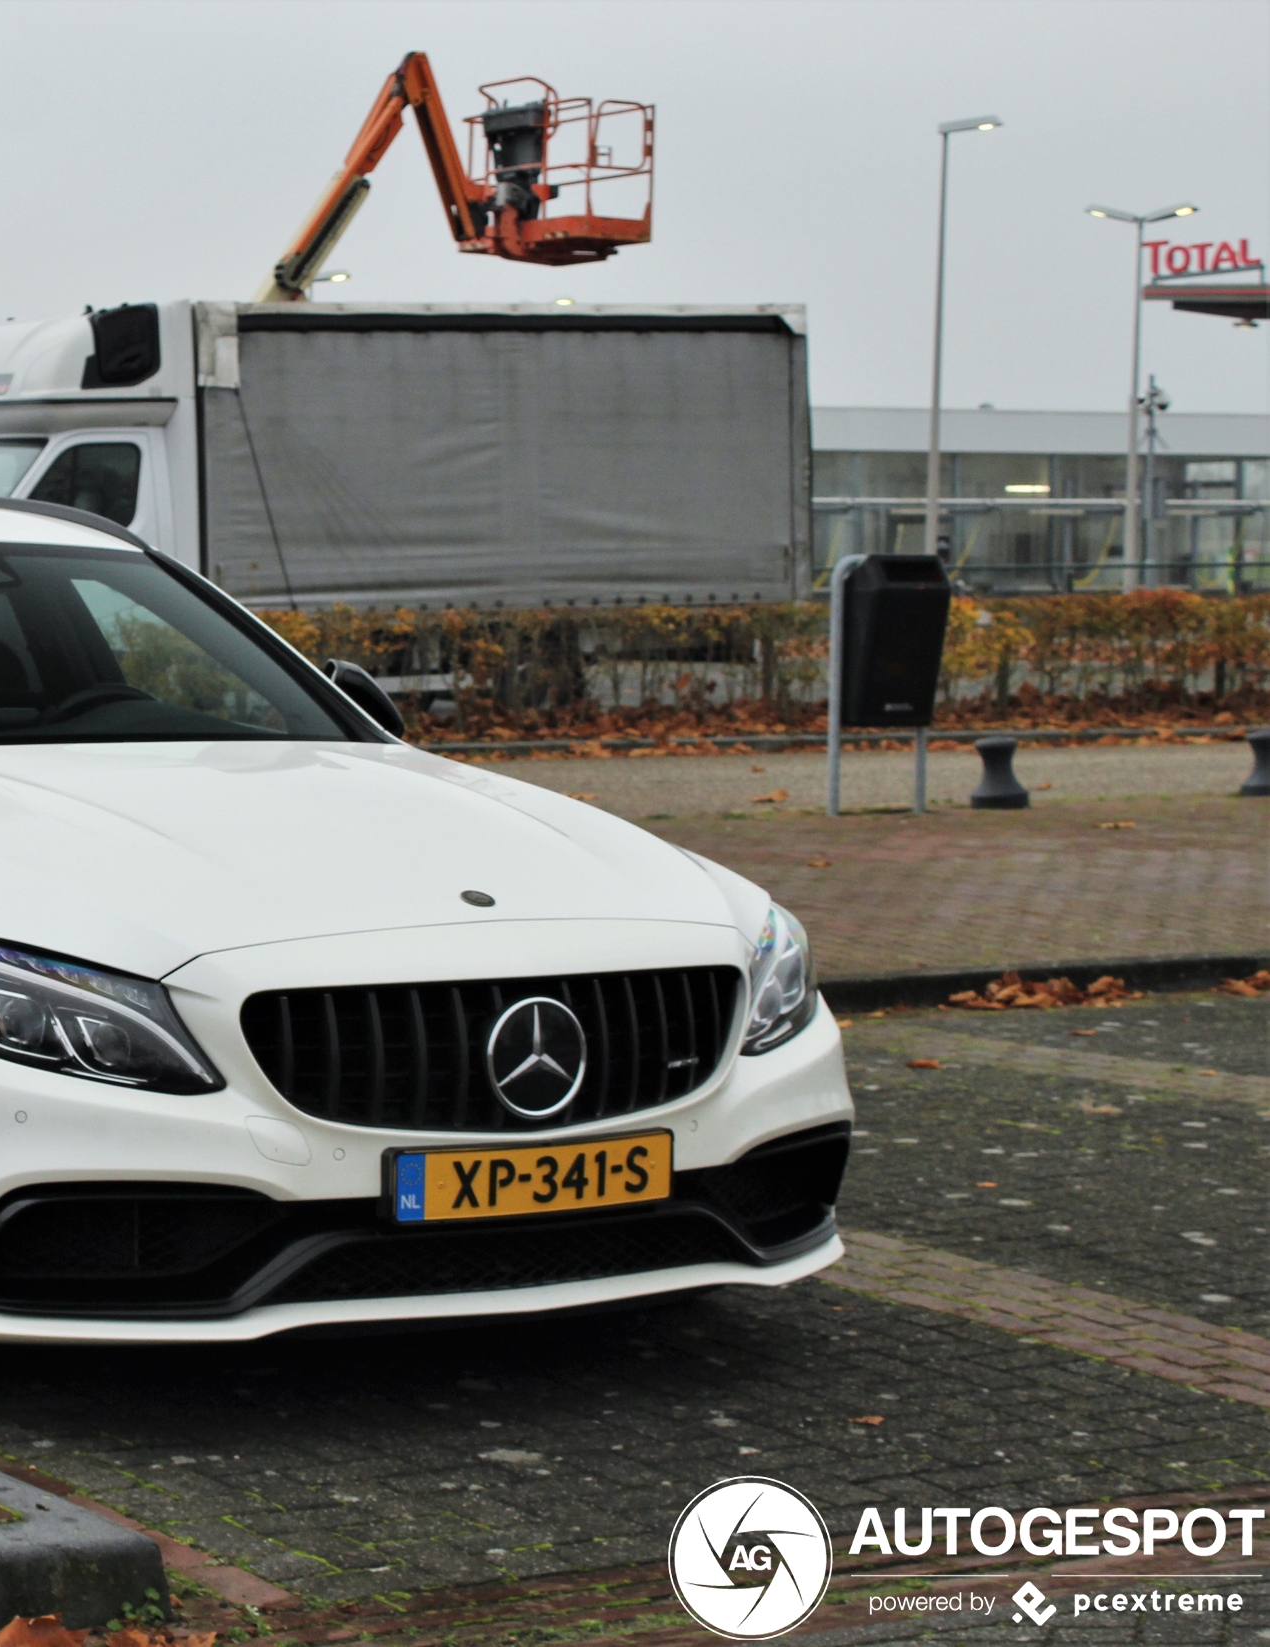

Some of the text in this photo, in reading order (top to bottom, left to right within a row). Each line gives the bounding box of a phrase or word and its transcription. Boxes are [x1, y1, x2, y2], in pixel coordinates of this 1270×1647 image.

[1141, 239, 1262, 276] TOTAL
[452, 1145, 649, 1209] XP-341-S
[400, 1194, 421, 1209] NL
